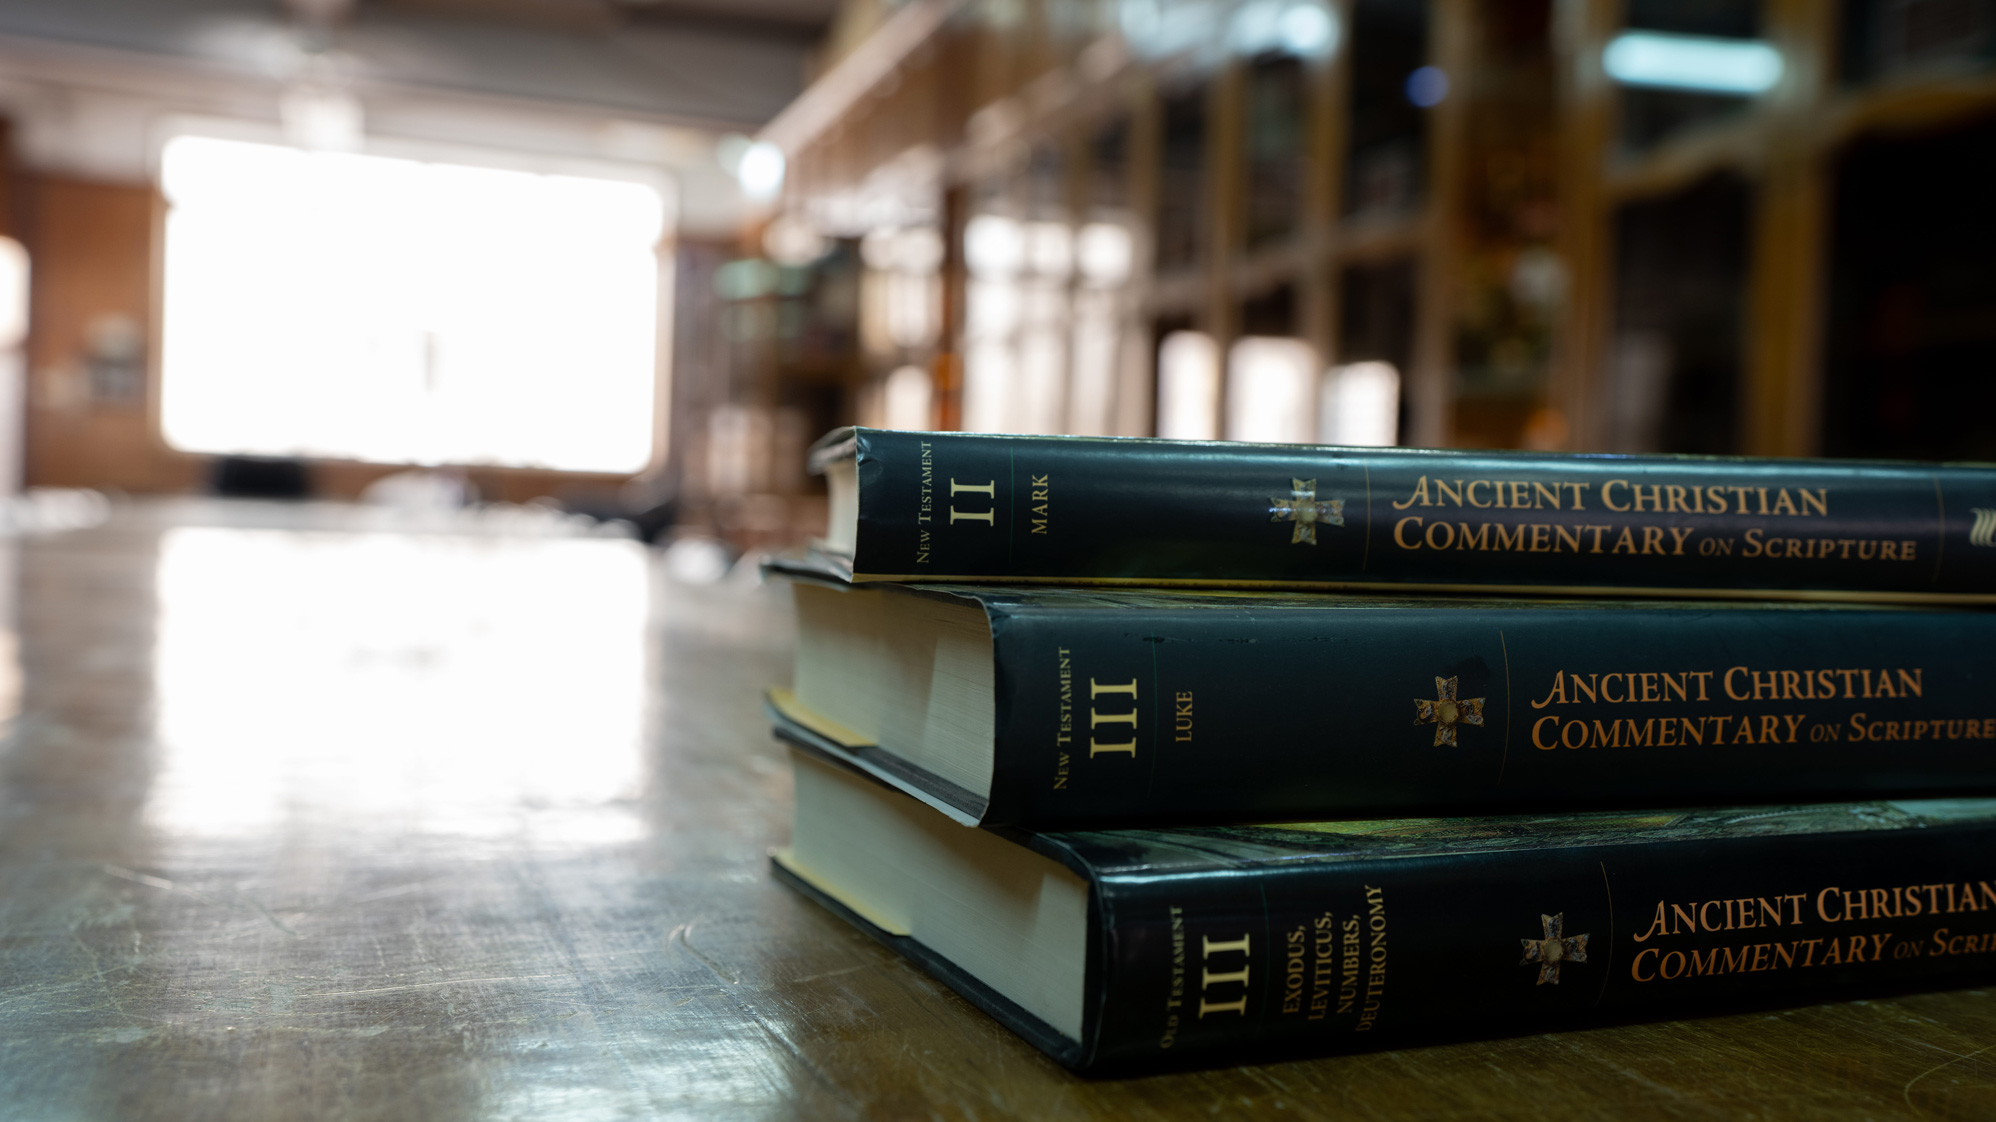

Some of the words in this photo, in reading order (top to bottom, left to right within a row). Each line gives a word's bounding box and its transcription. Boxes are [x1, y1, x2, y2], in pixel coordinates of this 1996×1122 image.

[918, 441, 932, 525] TESTAMENT
[949, 477, 995, 527] II
[1031, 474, 1049, 535] MARK
[1392, 475, 1590, 510] ANCIENT
[1601, 479, 1828, 517] CHRISTIAN
[916, 530, 931, 564] NEW
[1393, 516, 1695, 556] COMMENTARY
[1699, 537, 1735, 557] ON
[1742, 528, 1918, 561] SCRIPTURE
[1056, 646, 1072, 747] TESTAMENT
[1530, 669, 1714, 709] ANCIENT
[1723, 666, 1923, 701] CHRISTIAN
[1089, 677, 1138, 759] III
[1175, 690, 1193, 743] LUKE
[1531, 714, 1807, 751] COMMENTARY
[1809, 723, 1842, 743] ON
[1847, 712, 1996, 742] SCRIPTURE
[1053, 751, 1070, 790] NEW
[1632, 893, 1807, 943] ANCIENT
[1167, 904, 1185, 1012] TESTAMENT
[1198, 932, 1250, 1019] III
[1282, 924, 1306, 1014] EXODUS,
[1308, 911, 1334, 1021] LEVITICUS,
[1336, 914, 1361, 1015] NUMBERS,
[1355, 884, 1387, 1033] DEUTERONOMY
[1631, 932, 1893, 982] COMMENTARY
[1893, 939, 1925, 960] ON
[1160, 1015, 1179, 1049] OLD
